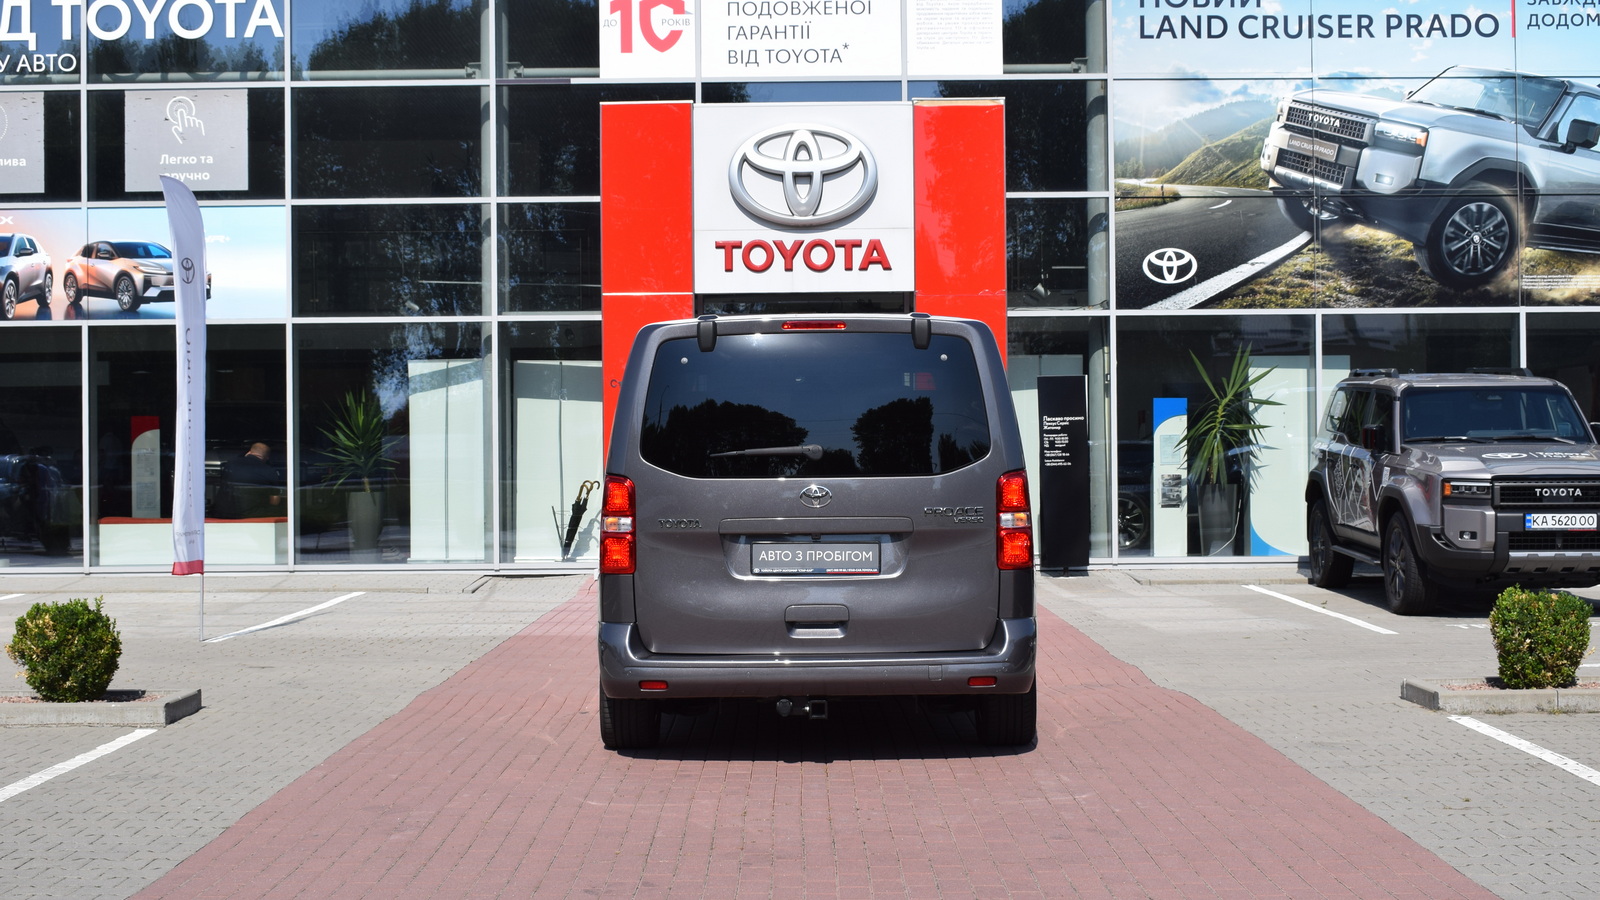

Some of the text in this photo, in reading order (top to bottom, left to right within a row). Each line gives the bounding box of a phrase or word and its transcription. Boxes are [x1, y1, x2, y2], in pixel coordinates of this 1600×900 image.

[51, 0, 284, 41] TOYOTA
[603, 19, 618, 28] ДО
[661, 18, 691, 27] РОКІВ
[1139, 13, 1499, 39] LAND CRUISER PRADO
[727, 21, 811, 40] ГАРАНТІЇ
[16, 53, 77, 73] АВТО
[727, 49, 760, 67] ВІД
[1309, 113, 1340, 127] TOYOTA
[1320, 147, 1334, 155] PRADO
[159, 153, 214, 165] Легко та
[714, 239, 892, 272] TOYOTA
[1535, 488, 1582, 497] TOYOTA
[924, 506, 984, 517] PROACE
[658, 518, 702, 529] TOYOTA
[1532, 515, 1548, 526] KA
[1551, 515, 1577, 526] 5620
[758, 550, 792, 561] АВТО
[806, 550, 873, 562] ПРОБІГОМ
